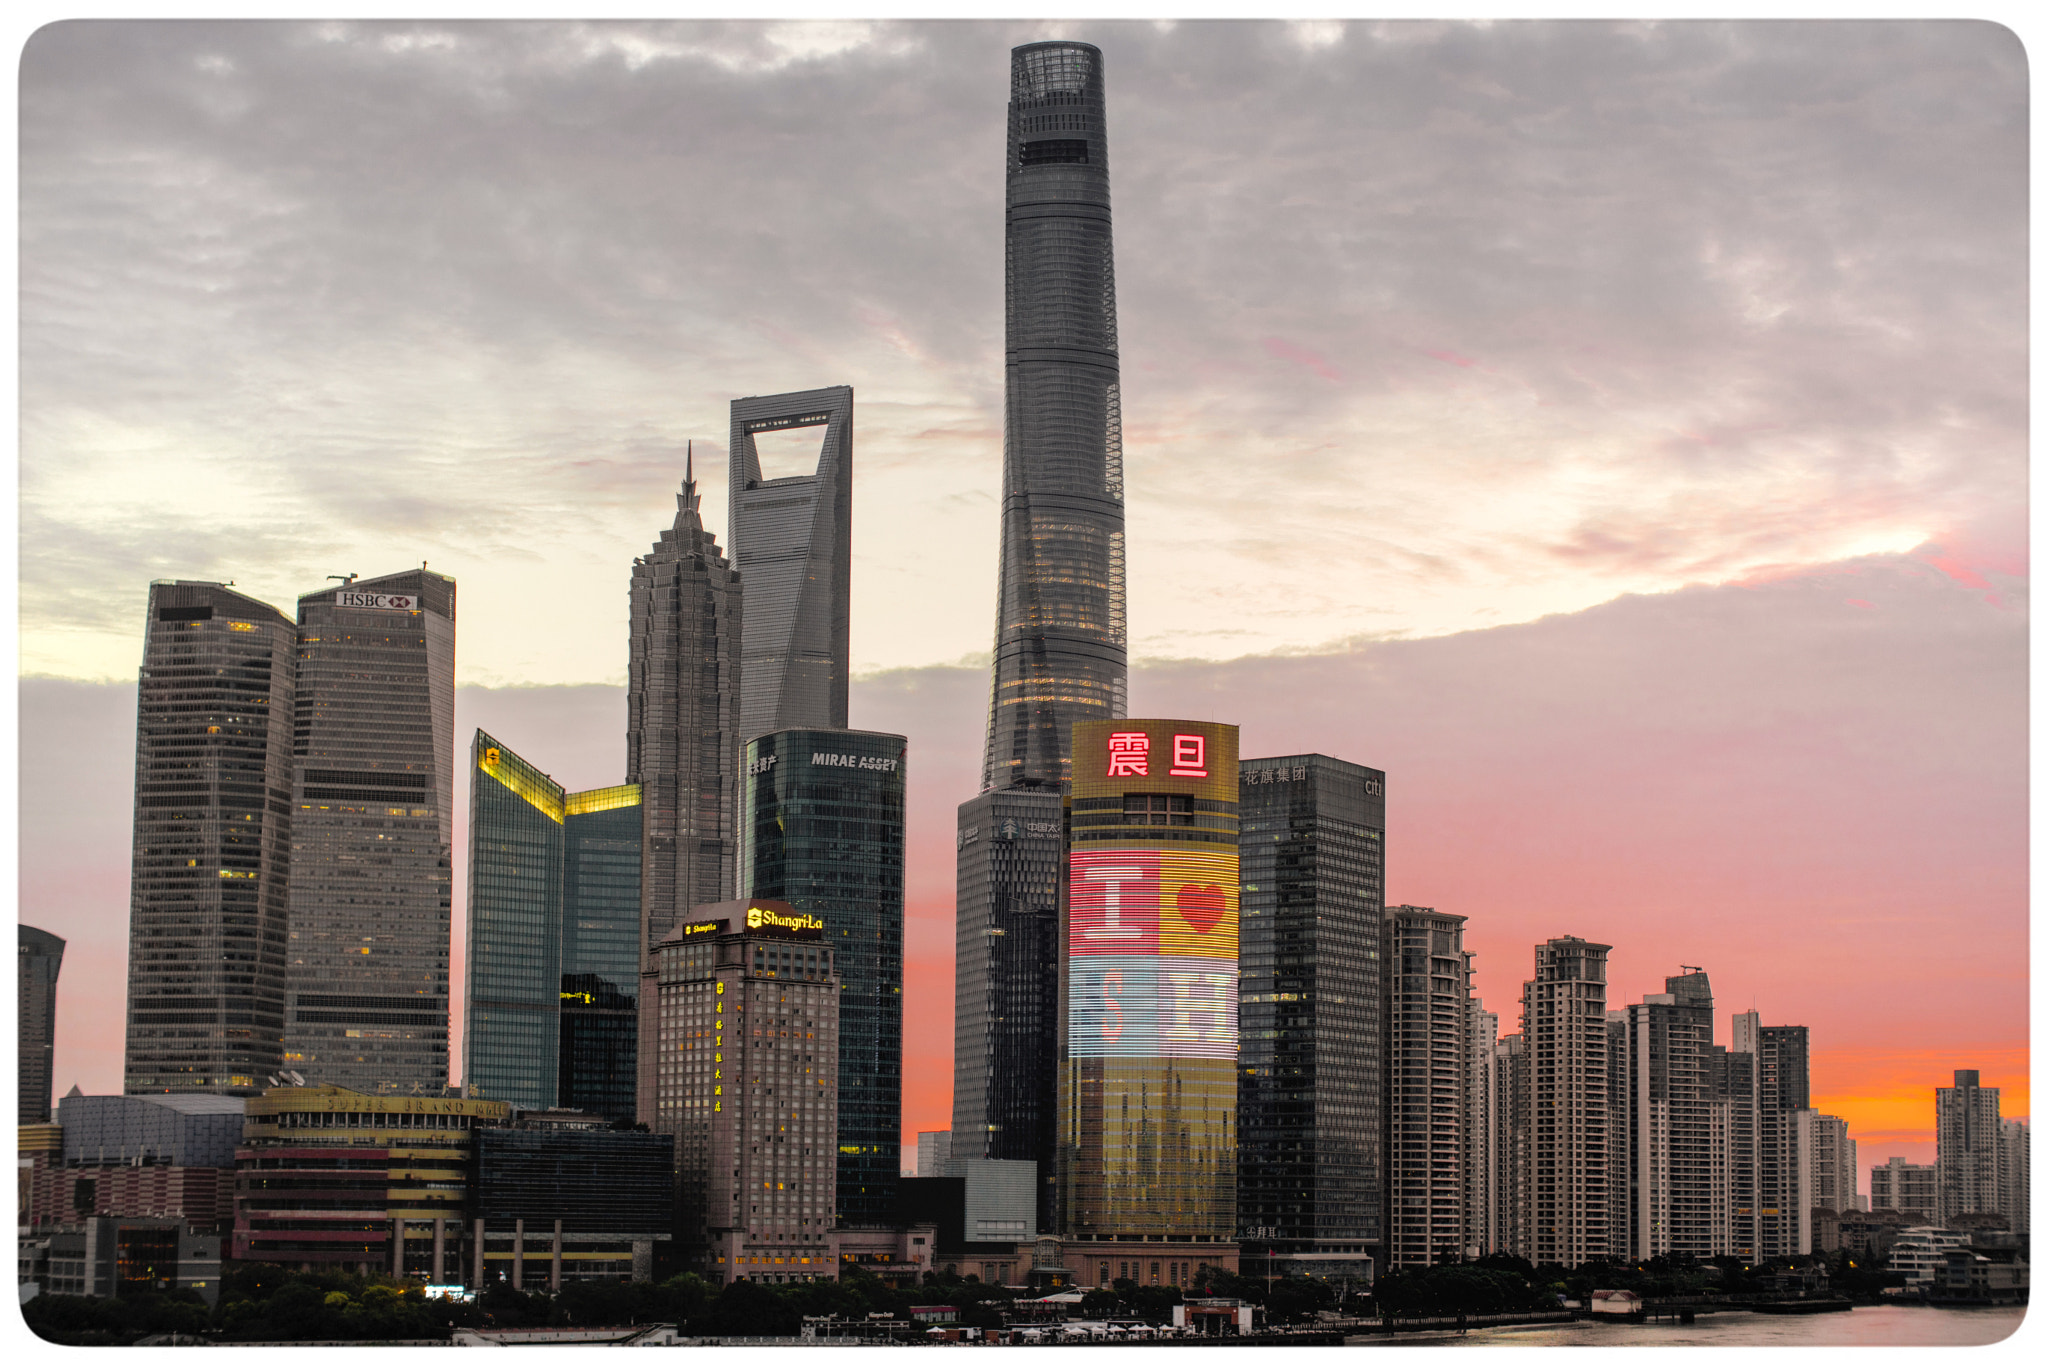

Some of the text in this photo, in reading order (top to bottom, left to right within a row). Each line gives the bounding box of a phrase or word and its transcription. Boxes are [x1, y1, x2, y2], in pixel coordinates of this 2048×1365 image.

[343, 593, 386, 607] HSBC
[811, 752, 898, 772] MIRAE ASSET
[1107, 732, 1208, 777] 震旦
[1245, 766, 1306, 786] 花旗集团
[1365, 776, 1382, 797] citi
[1027, 822, 1060, 833] 中国太
[1084, 867, 1143, 939] I
[762, 910, 823, 931] Shangri-La
[404, 1101, 464, 1113] BRAND
